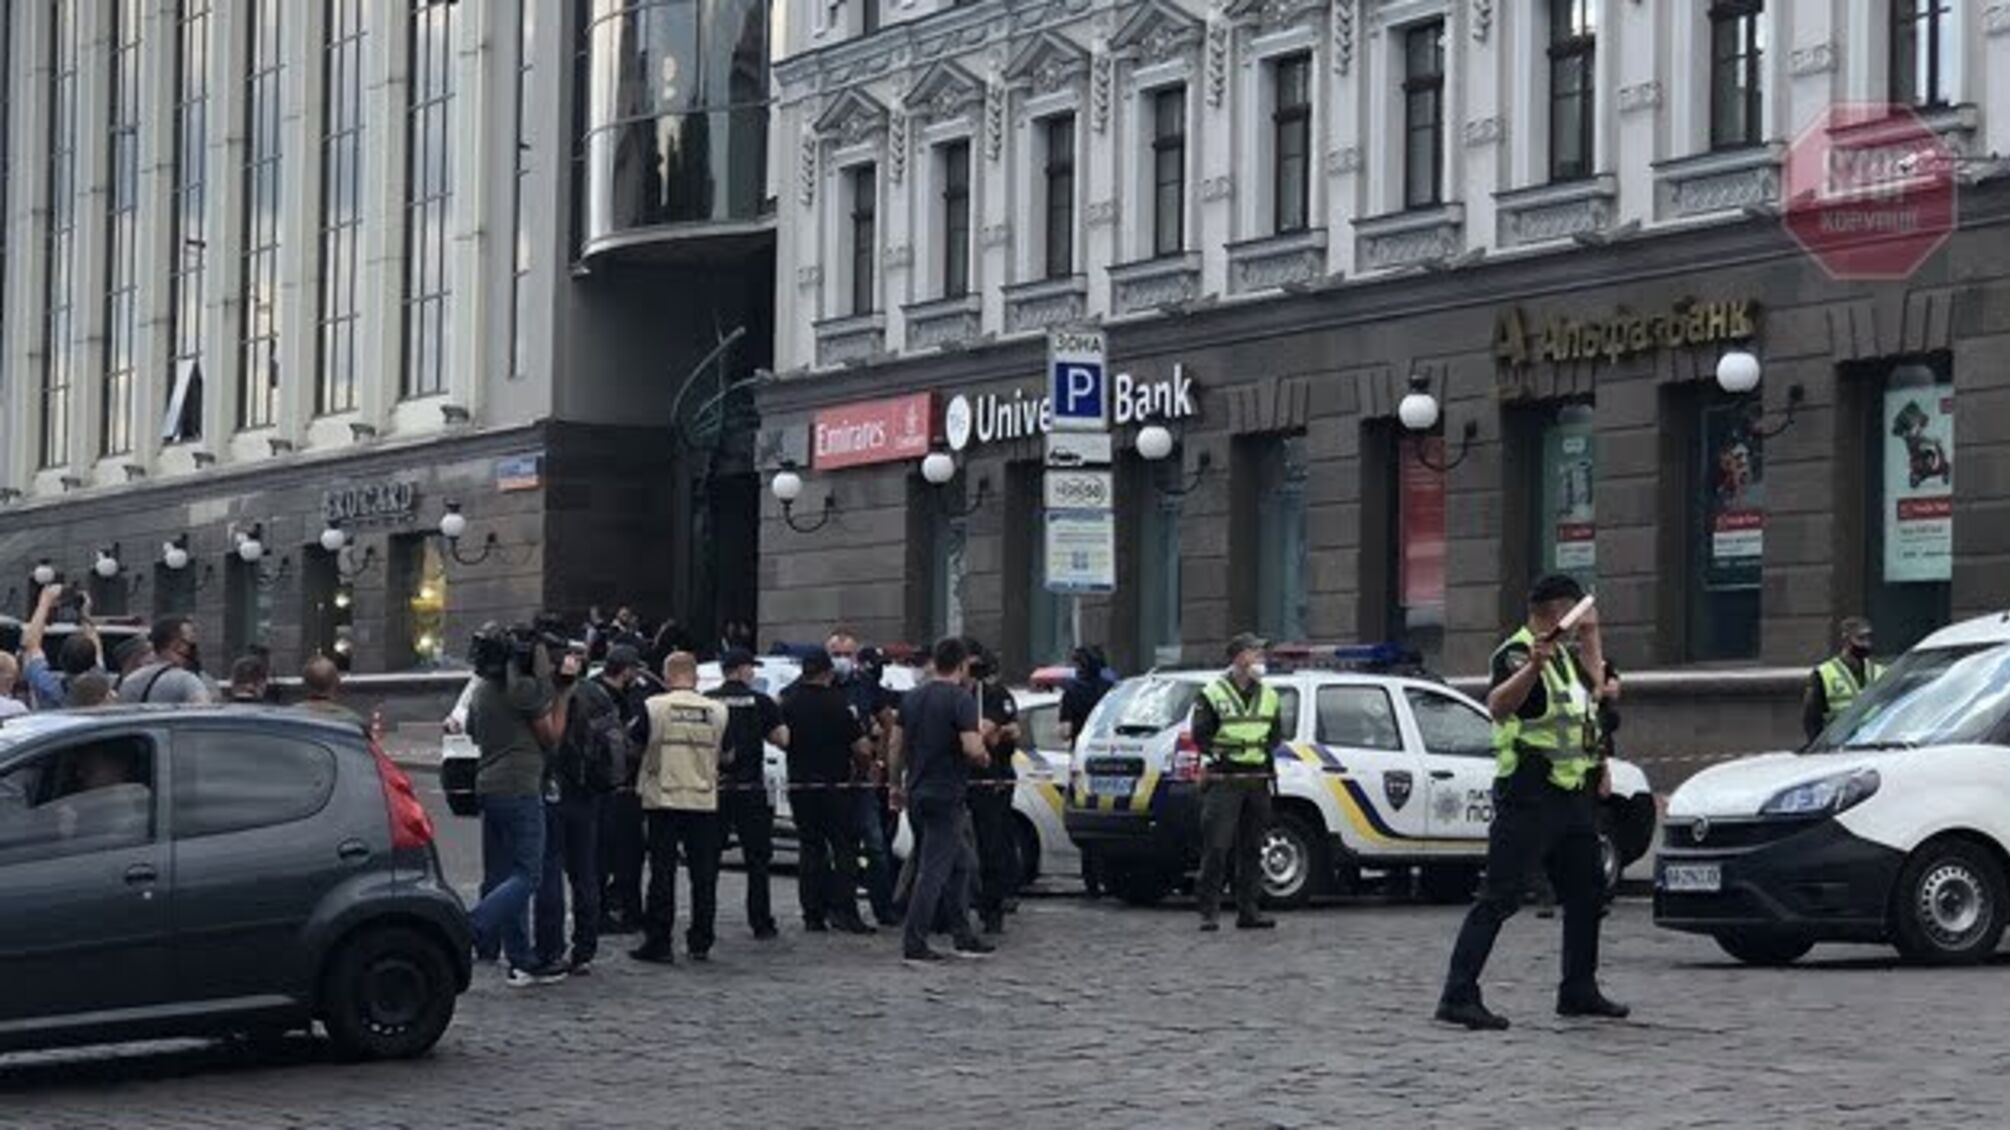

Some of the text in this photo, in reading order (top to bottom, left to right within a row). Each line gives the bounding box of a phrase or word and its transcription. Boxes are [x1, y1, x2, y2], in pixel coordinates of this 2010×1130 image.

[1054, 332, 1102, 354] ЗОНА
[1067, 367, 1095, 413] P
[1114, 362, 1193, 425] Bank
[815, 419, 886, 457] Emirates
